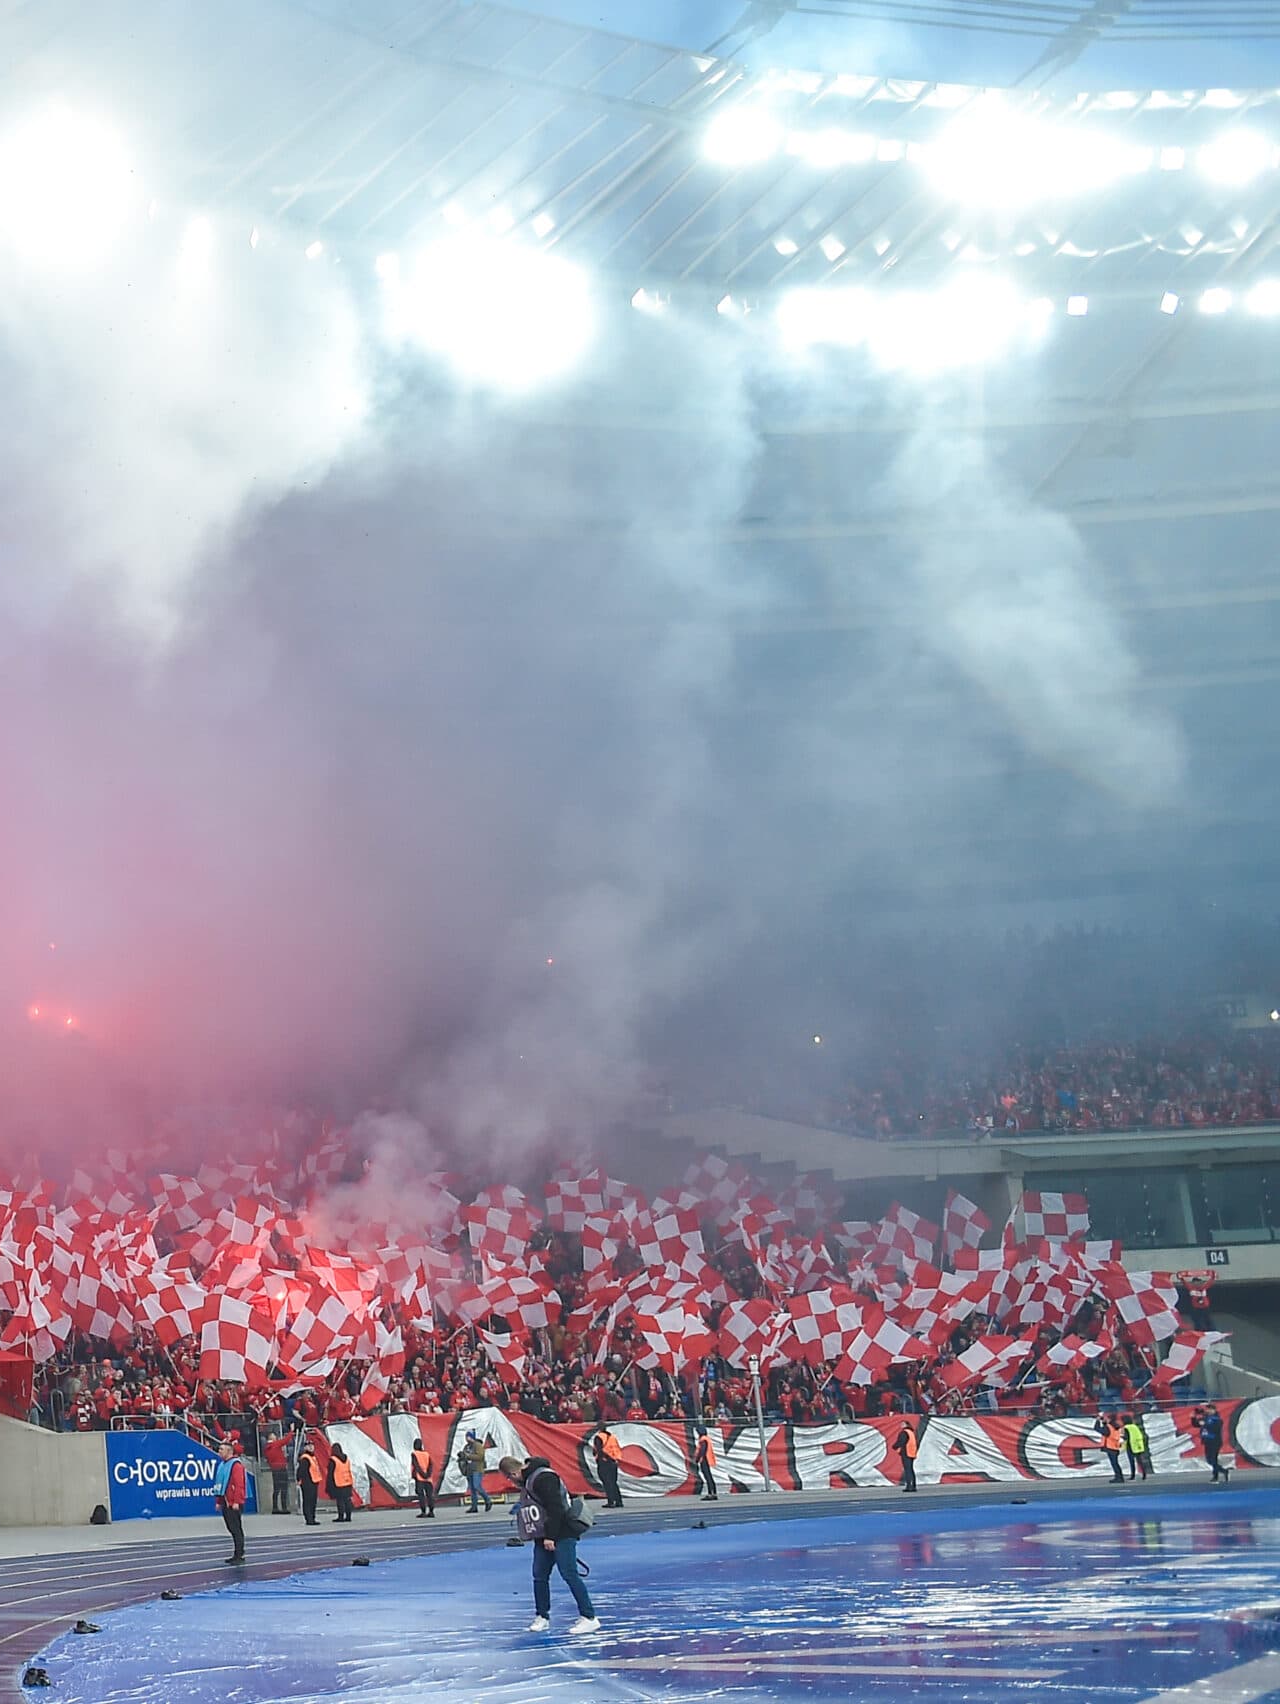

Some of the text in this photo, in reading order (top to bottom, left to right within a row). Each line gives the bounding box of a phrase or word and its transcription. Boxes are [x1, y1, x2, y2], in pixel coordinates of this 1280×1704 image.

[1210, 1251, 1224, 1263] 04
[322, 1406, 532, 1502] NA
[156, 1486, 191, 1501] wprawia
[192, 1488, 200, 1497] w
[201, 1487, 216, 1497] ruc
